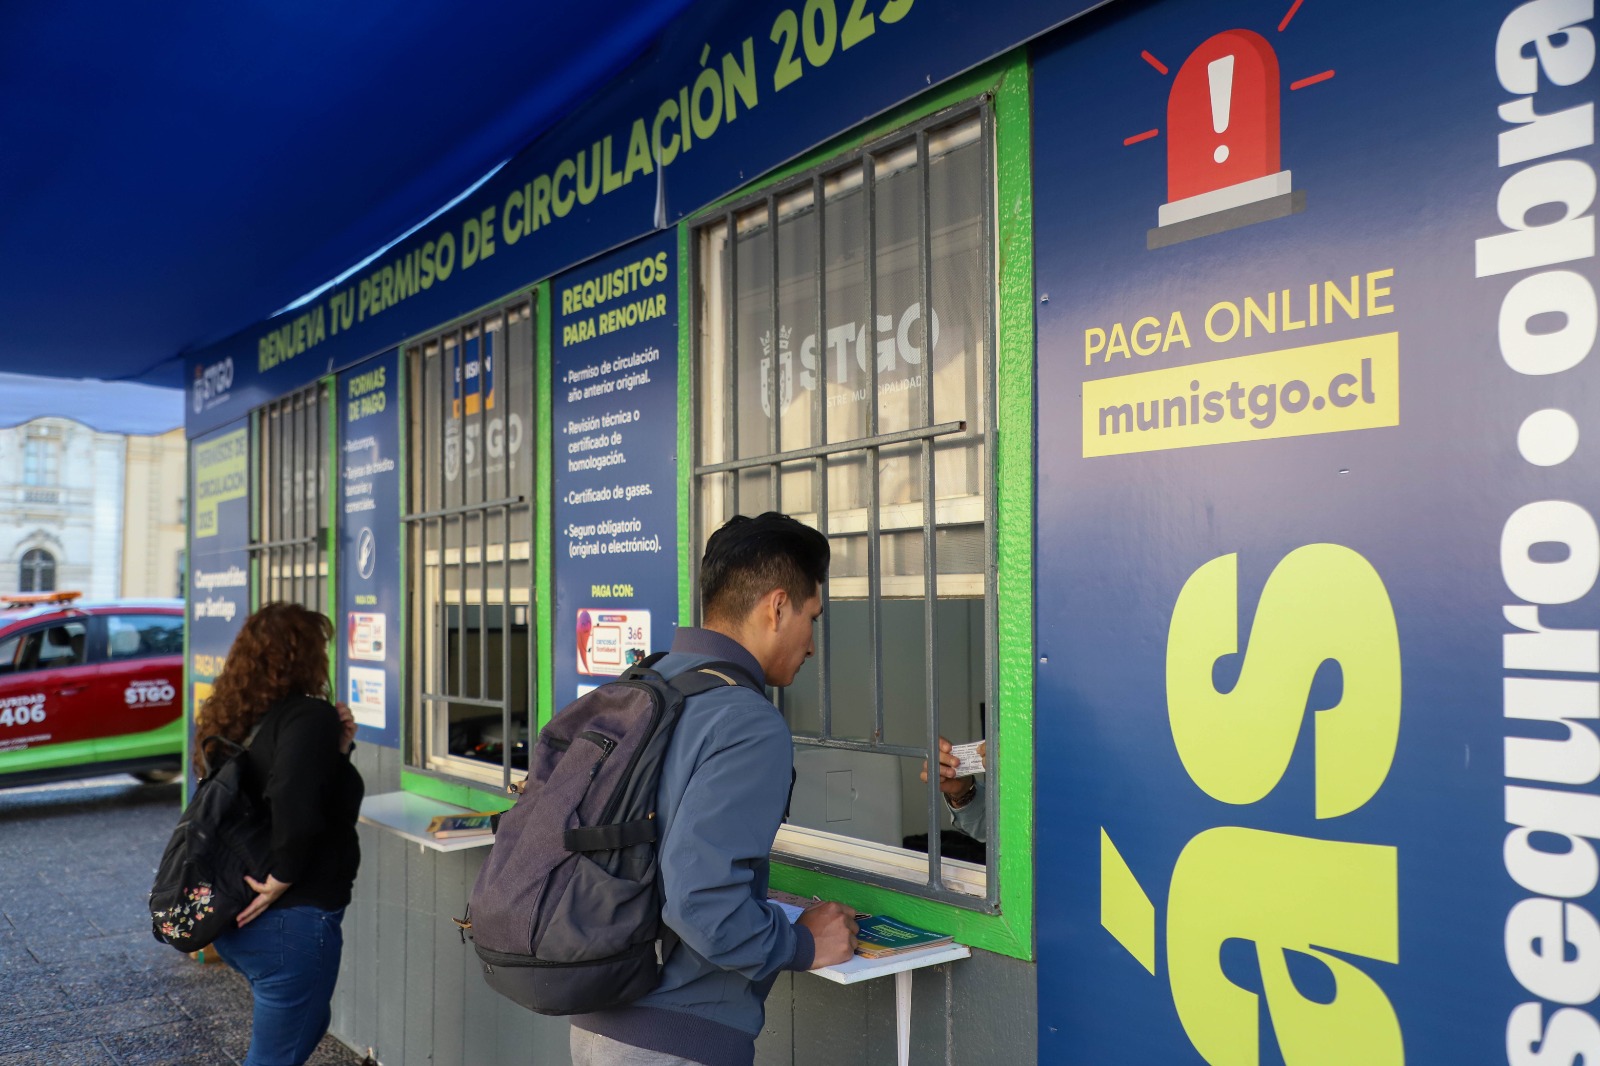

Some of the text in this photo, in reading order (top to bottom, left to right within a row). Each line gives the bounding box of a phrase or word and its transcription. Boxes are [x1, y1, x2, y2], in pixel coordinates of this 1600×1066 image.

[258, 0, 914, 373] RENUEVA TU PERMISO DE CIRCULACIÓN 202
[562, 251, 668, 316] REQUISITOS
[563, 293, 667, 348] PARA RENOVAR
[1085, 268, 1394, 366] PAGA ONLINE
[568, 347, 660, 384] Permiso de circulación
[349, 366, 386, 399] FORMAS
[567, 369, 651, 402] año anterior original.
[1099, 357, 1376, 437] munistgo.cl
[568, 410, 640, 435] Revisión técnica o
[568, 431, 622, 453] certificado de
[568, 449, 626, 472] homologación.
[569, 483, 652, 504] Certificado de gases.
[569, 517, 641, 540] Seguro obligatorio
[569, 534, 661, 558] (original o electrónico).
[591, 584, 634, 597] PAGA CON:
[124, 685, 176, 705] STGO
